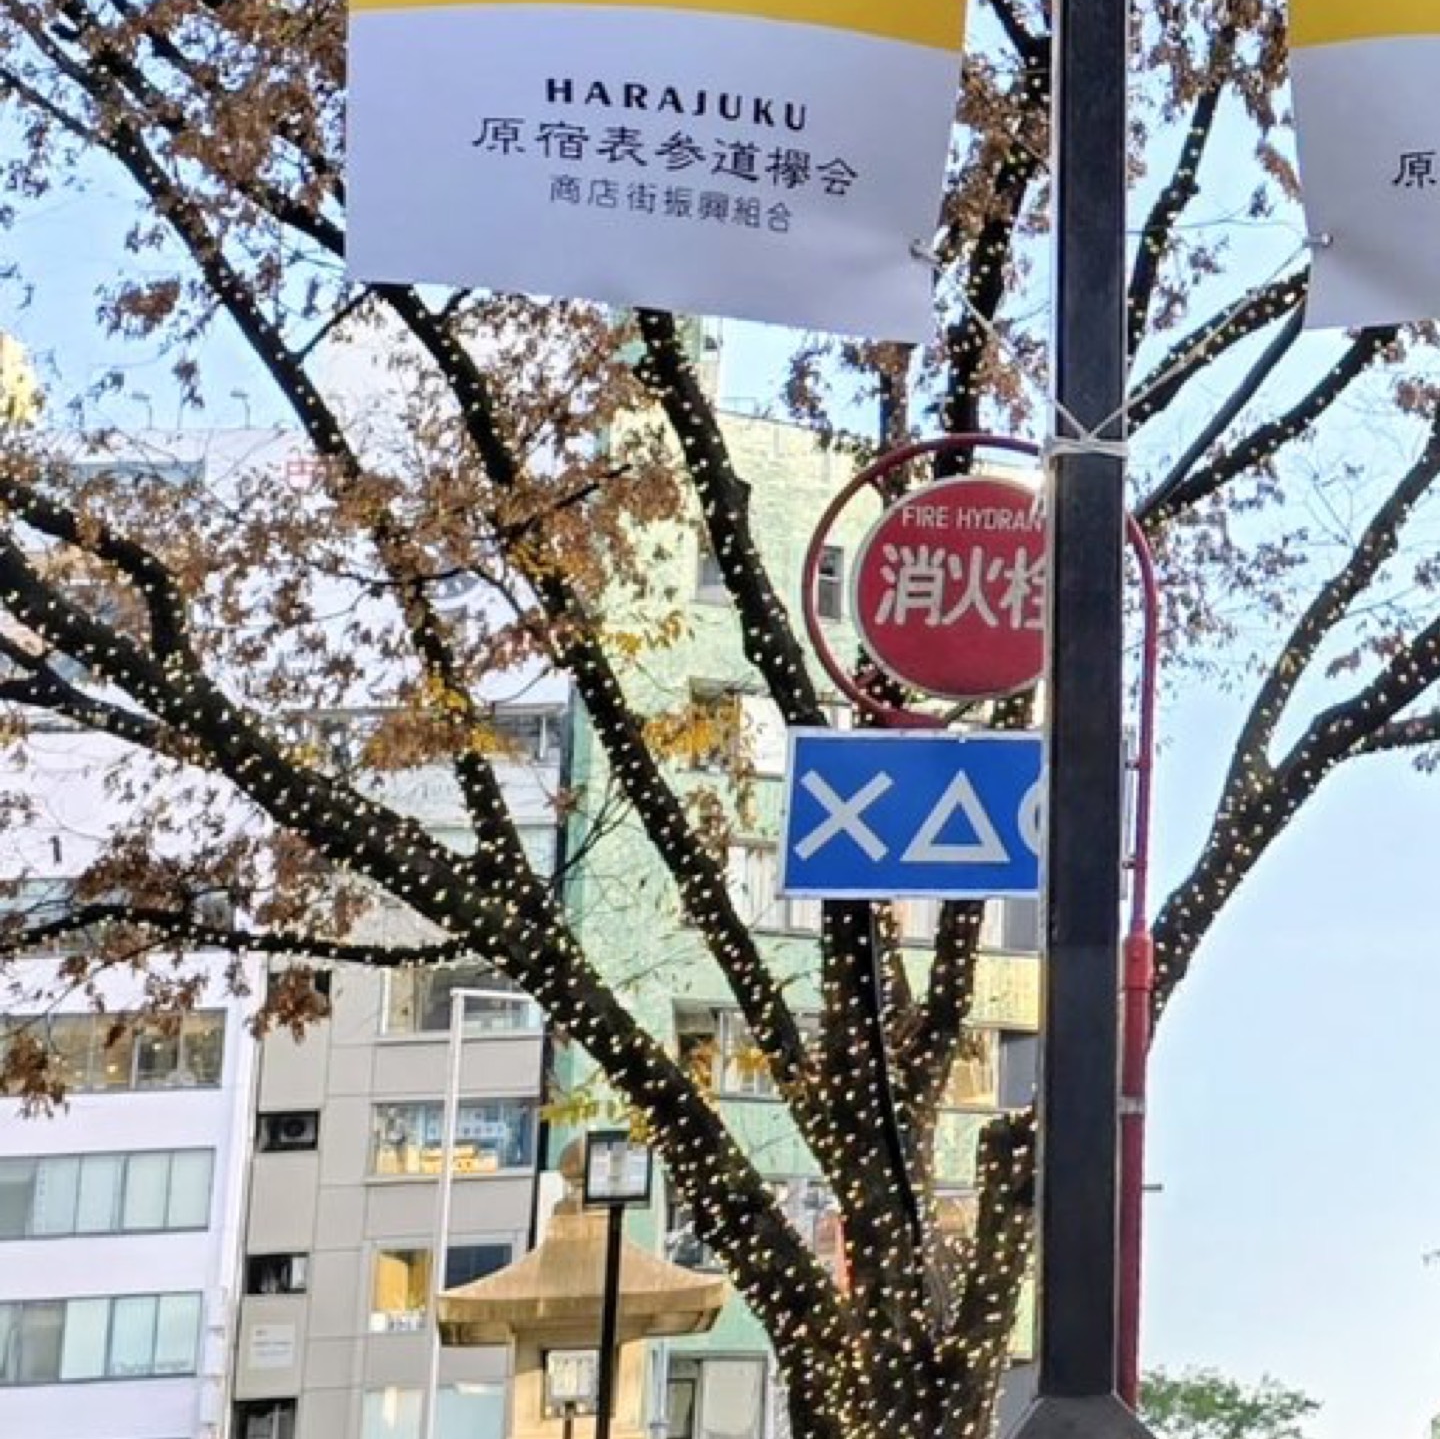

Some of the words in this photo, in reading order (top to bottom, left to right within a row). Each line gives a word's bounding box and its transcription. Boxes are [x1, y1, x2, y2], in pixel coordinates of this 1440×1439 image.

[545, 78, 809, 132] HARAJUKU
[471, 116, 860, 197] 原宿表参道欅会
[549, 173, 794, 234] 商店街振興組合
[902, 505, 949, 530] FIRE
[955, 506, 1043, 533] HYDRAN
[874, 543, 1049, 631] 消火栓
